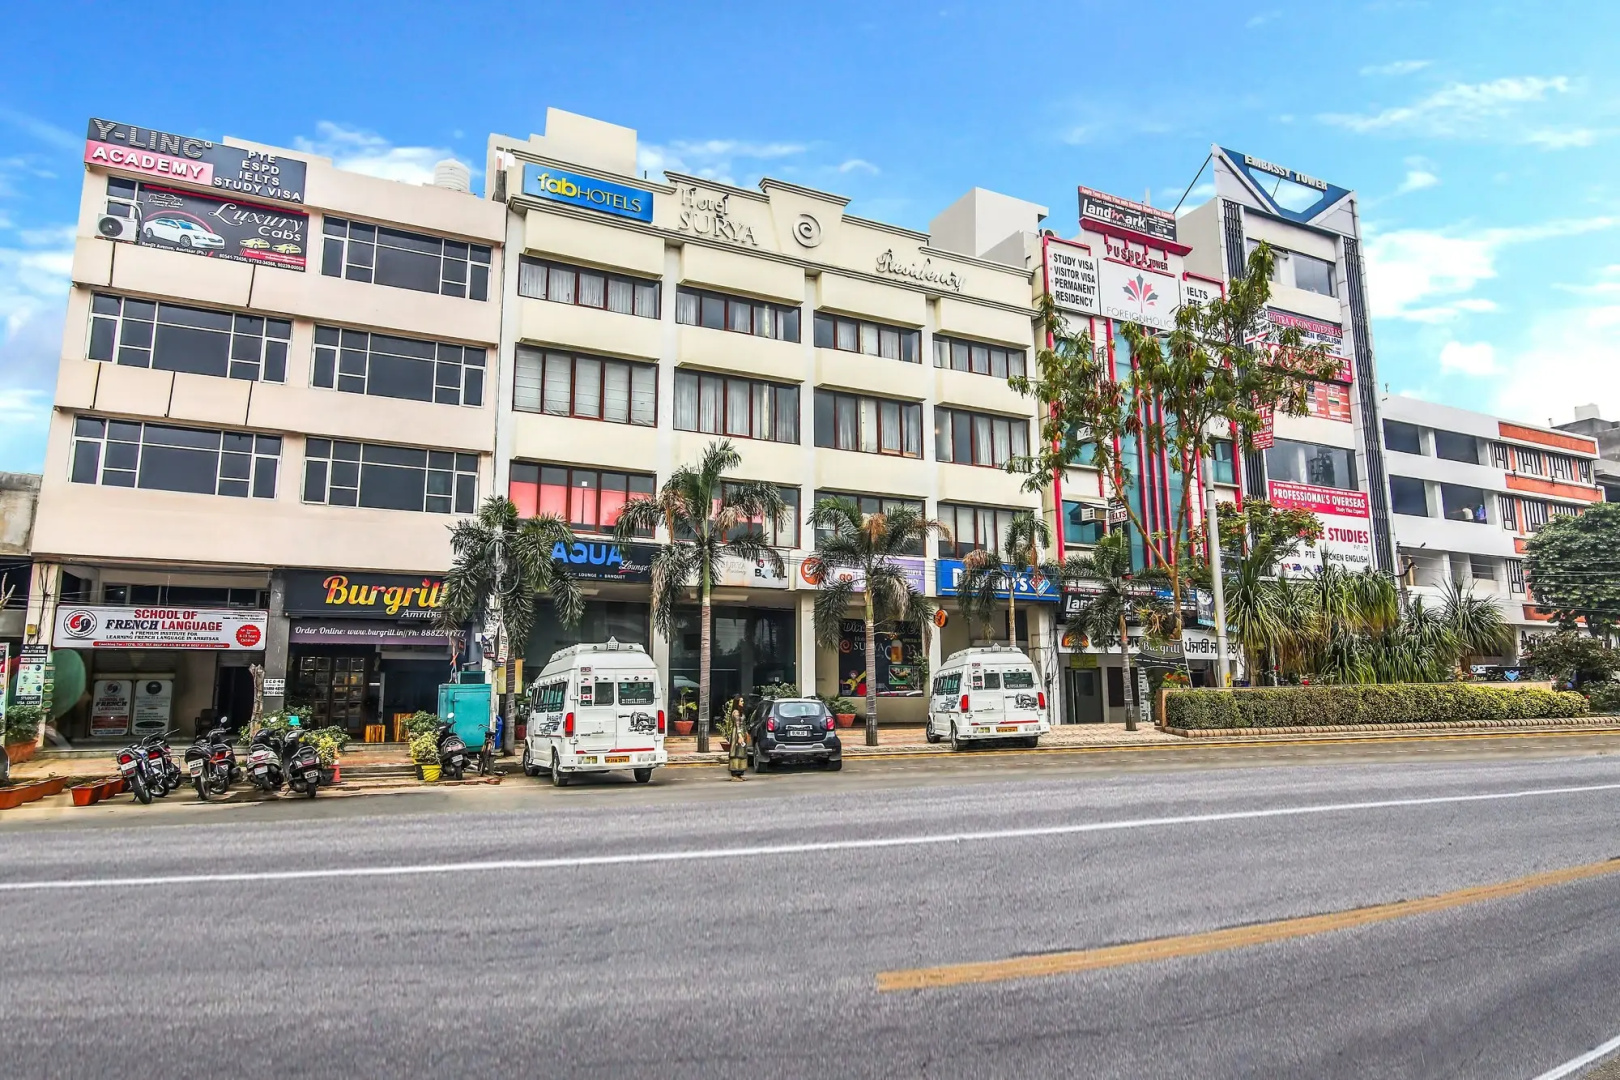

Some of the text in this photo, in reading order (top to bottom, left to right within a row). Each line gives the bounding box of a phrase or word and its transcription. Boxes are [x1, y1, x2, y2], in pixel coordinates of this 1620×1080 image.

[92, 146, 204, 178] ACADEMY
[248, 150, 276, 164] PTE
[242, 160, 280, 175] ESPD
[1244, 154, 1328, 190] EMBASSY TOWER
[239, 171, 280, 186] IELTS
[214, 177, 301, 201] STUDY VISA
[208, 202, 302, 233] Luxury
[1082, 199, 1146, 228] Landmark
[258, 226, 302, 242] Cabs
[678, 210, 759, 246] SURYA
[1110, 220, 1146, 233] IMMIGRATION
[876, 250, 966, 292] Residency
[1054, 253, 1094, 272] STUDY VISA
[1054, 266, 1096, 284] VISITOR VISA
[1055, 278, 1096, 296] PERMANENT
[1186, 286, 1208, 300] IELTS
[1056, 290, 1093, 308] RESIDENCY
[1296, 319, 1312, 331] SONS
[1312, 322, 1342, 338] OVERSEAS
[1272, 487, 1330, 504] PROFESSIONAL'S
[1332, 496, 1366, 508] OVERSEAS
[1328, 528, 1368, 544] STUDIES
[551, 541, 623, 566] AQUA
[1305, 550, 1316, 558] PTE
[134, 609, 198, 620] SCHOOL OF
[105, 619, 222, 631] FRENCH LANGUAGE
[295, 626, 318, 634] Order
[319, 626, 346, 635] Online:
